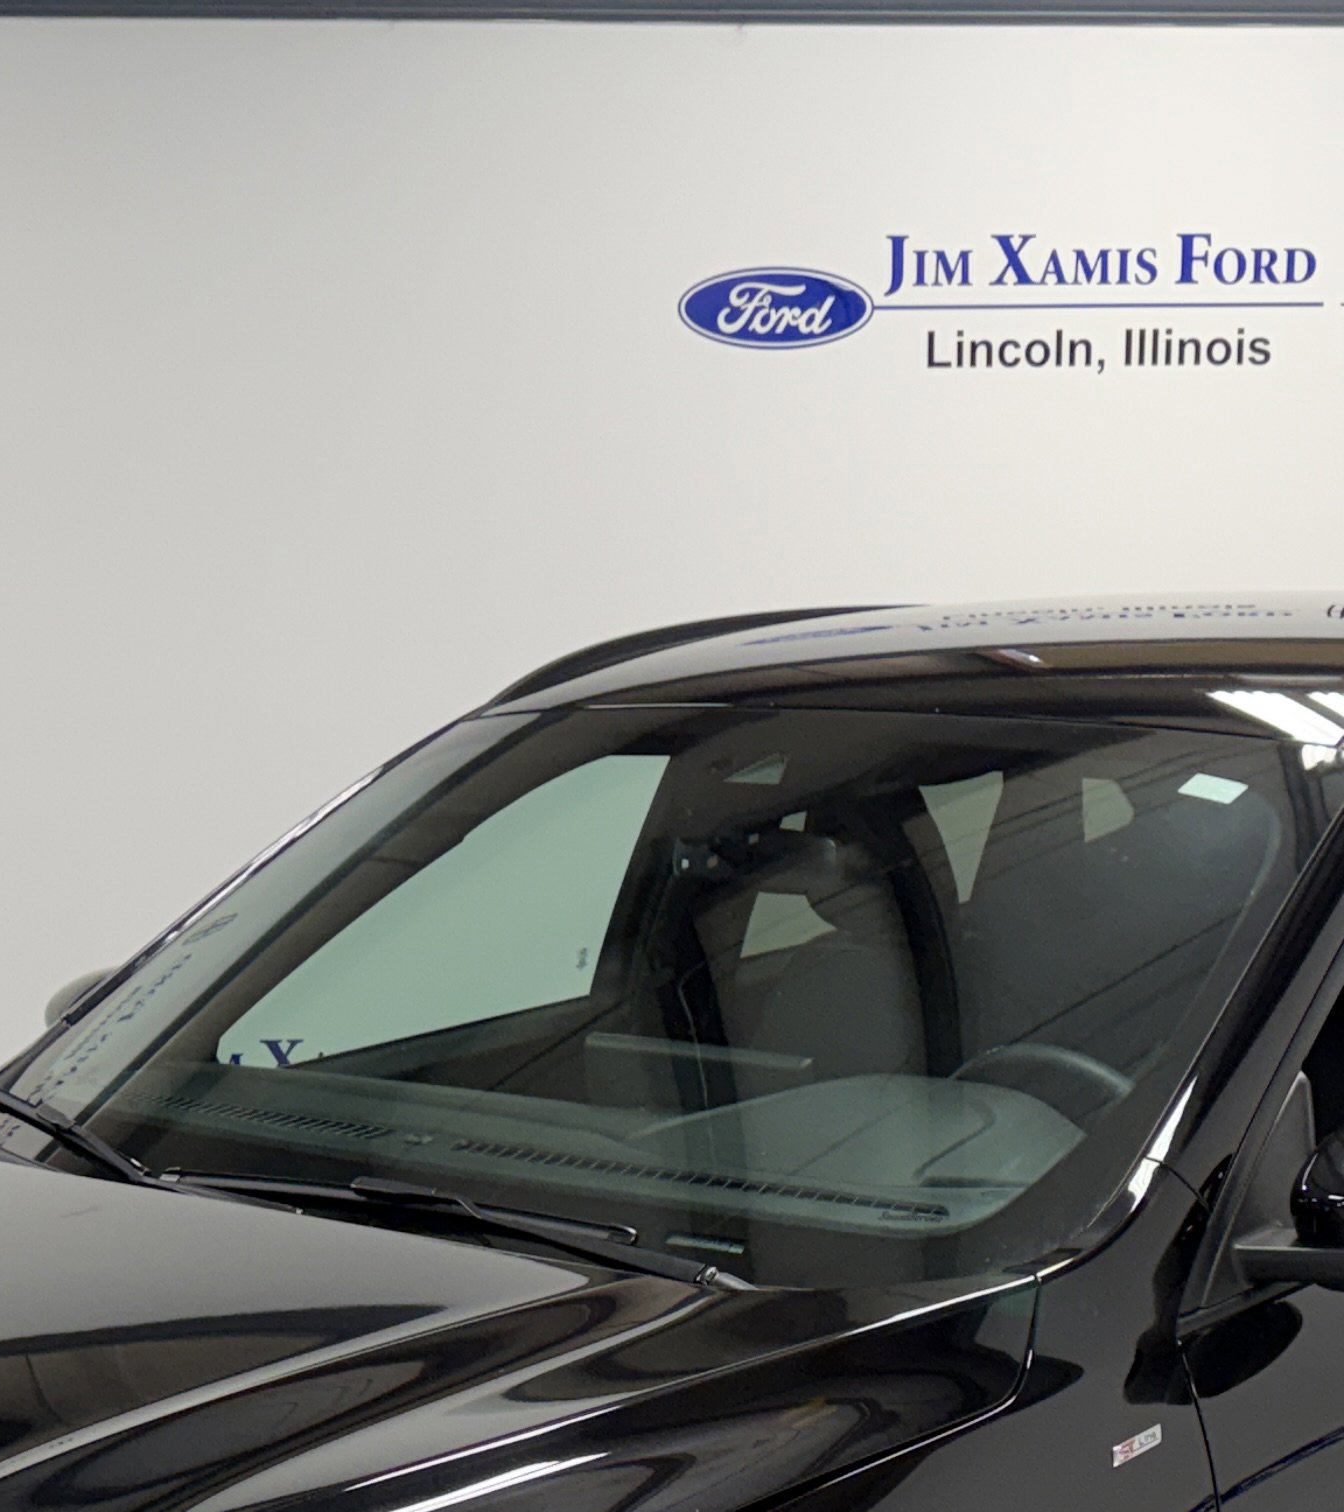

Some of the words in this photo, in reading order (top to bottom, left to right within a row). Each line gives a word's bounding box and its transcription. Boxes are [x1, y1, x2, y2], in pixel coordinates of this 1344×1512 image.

[884, 235, 972, 296] JIM
[989, 234, 1158, 286] XAMIS
[1175, 233, 1317, 285] FORD
[717, 281, 833, 336] Ford
[927, 329, 1106, 374] Lincoln,
[1124, 328, 1271, 366] Illinois
